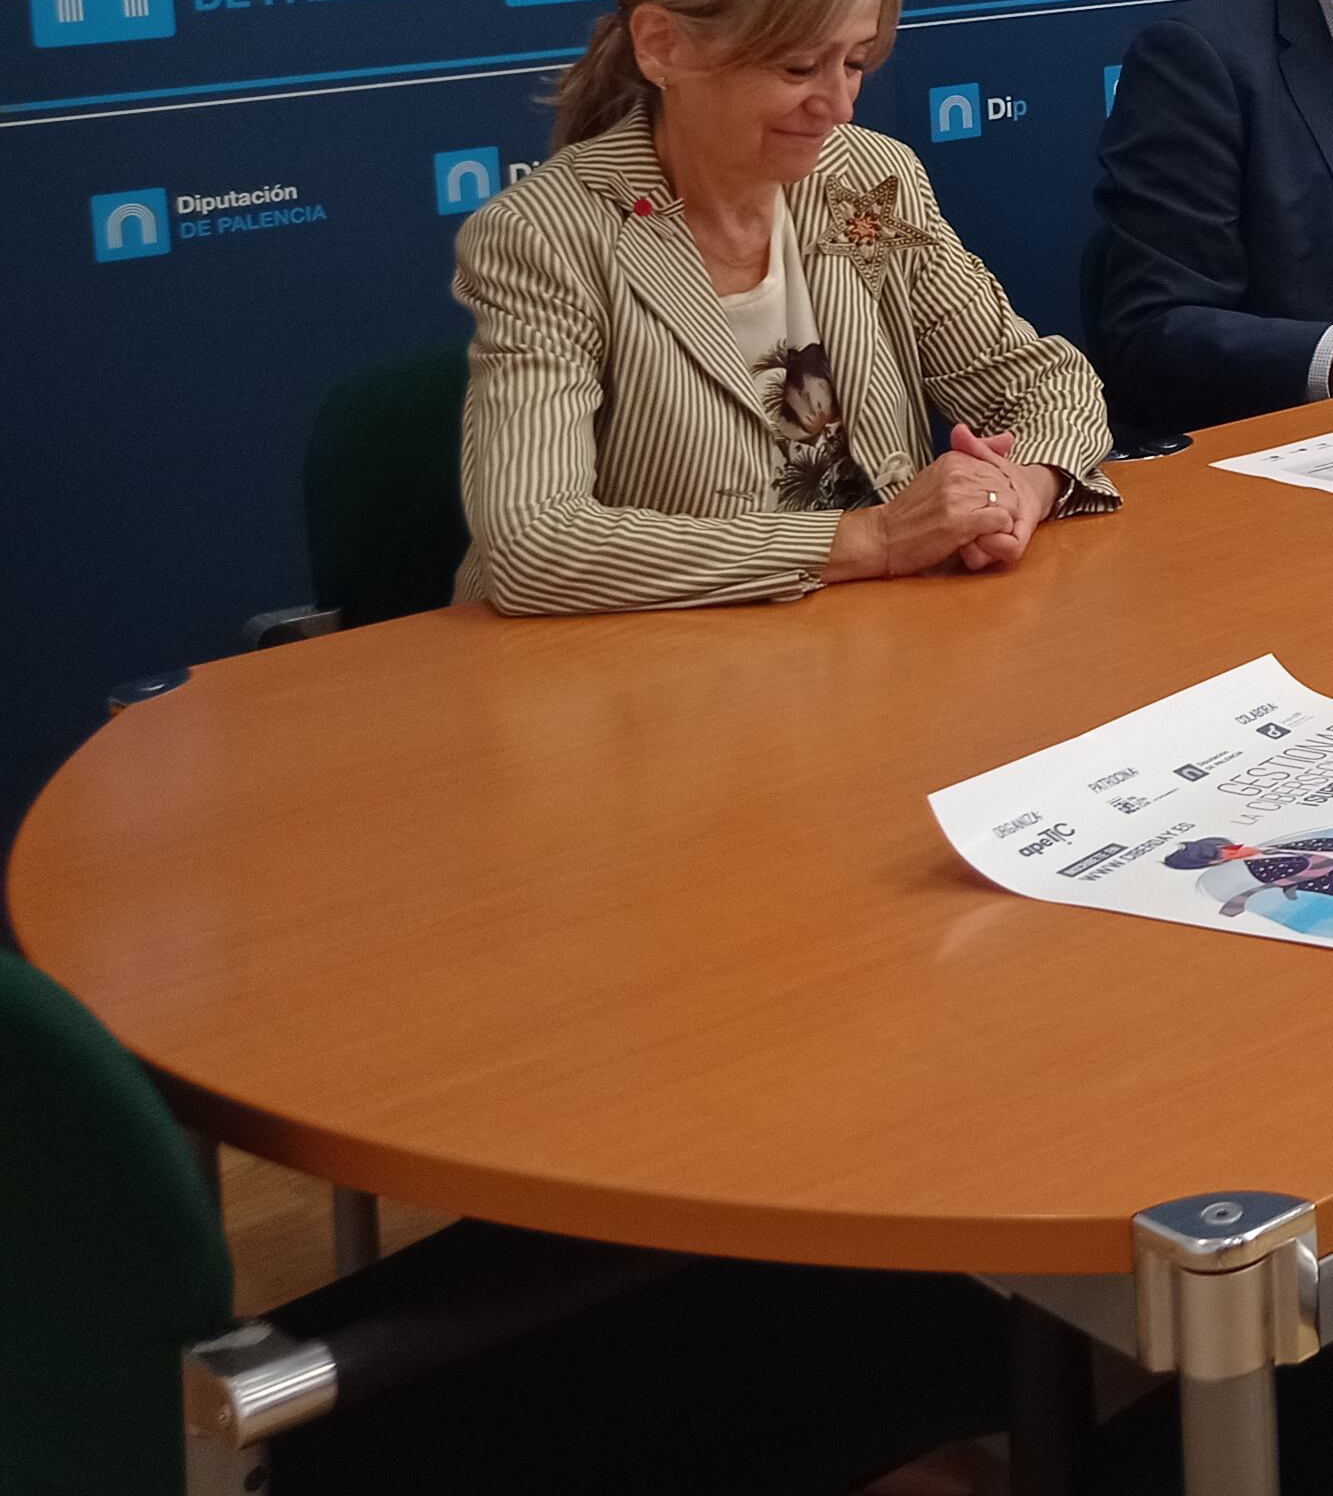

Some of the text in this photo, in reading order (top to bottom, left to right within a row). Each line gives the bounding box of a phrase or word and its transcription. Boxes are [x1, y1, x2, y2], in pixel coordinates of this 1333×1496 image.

[177, 185, 297, 214] Diputación
[181, 205, 326, 238] DE PALENCIA
